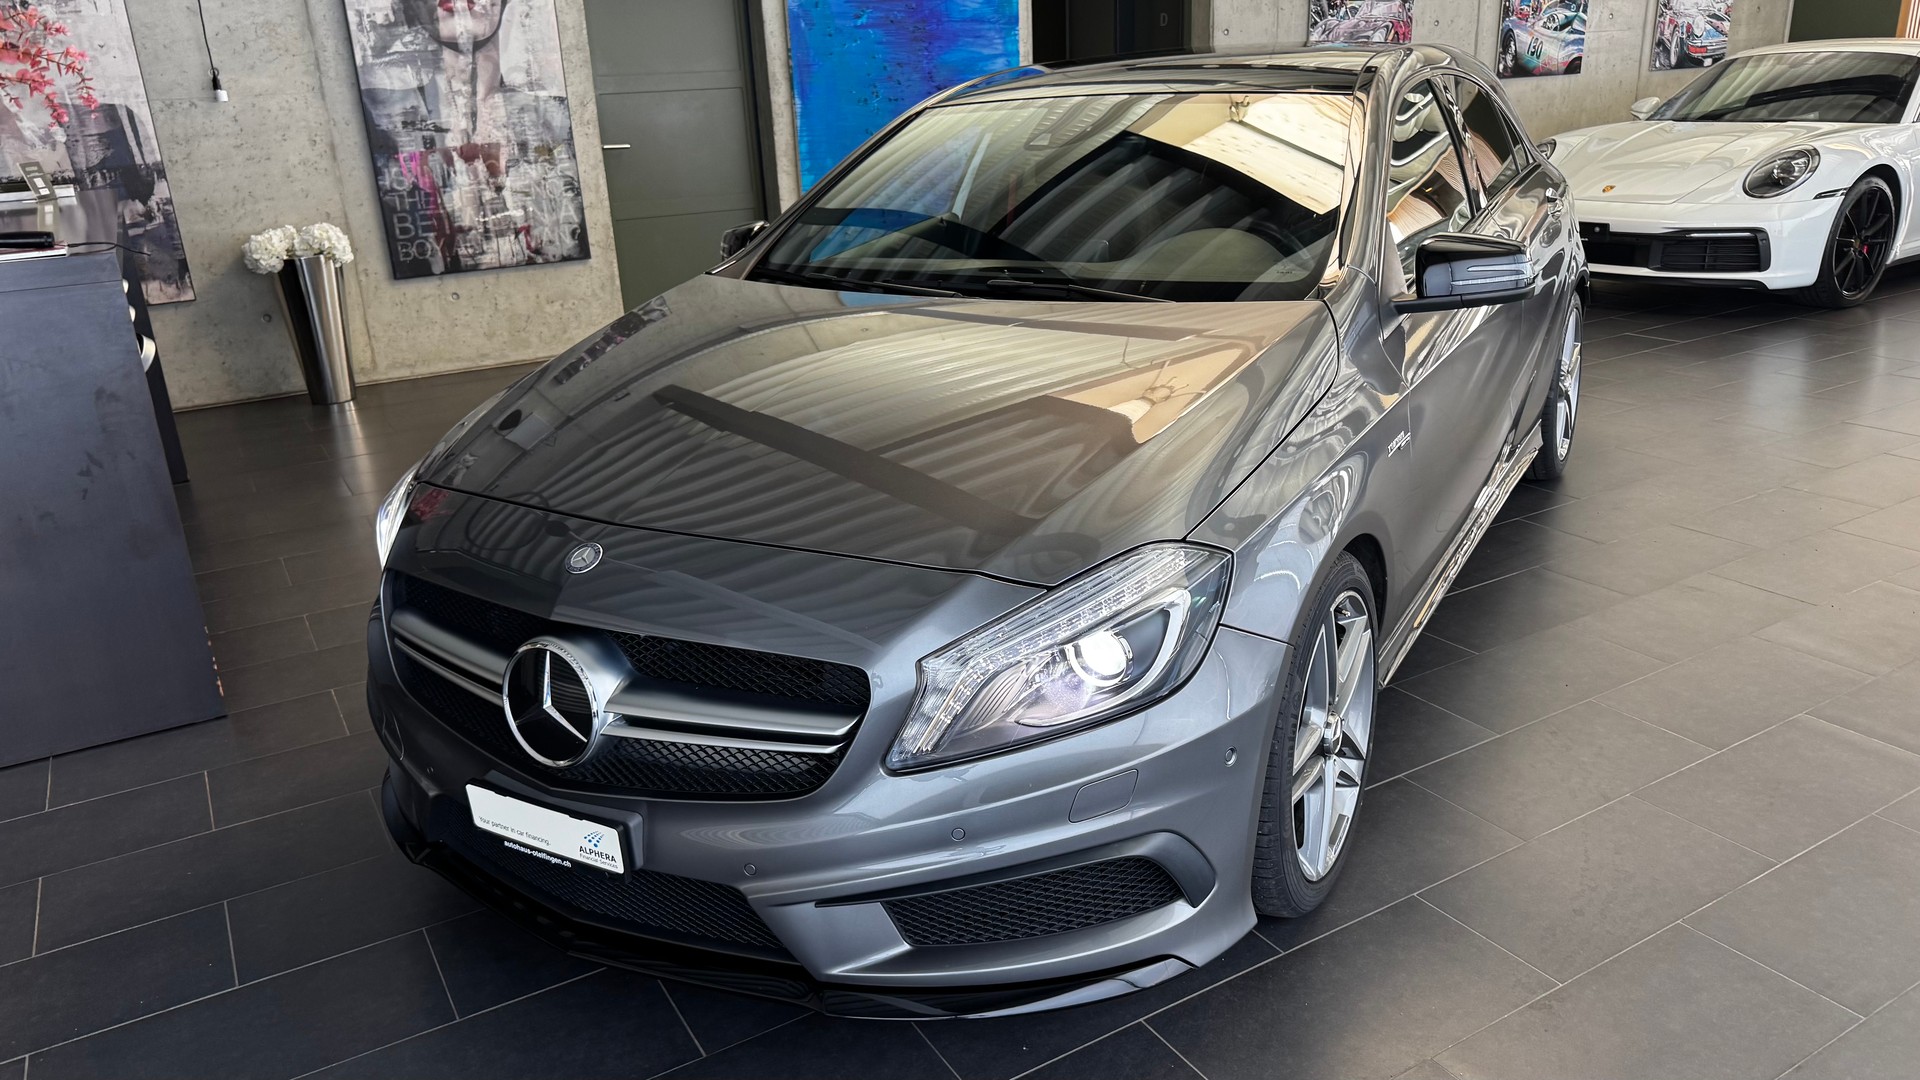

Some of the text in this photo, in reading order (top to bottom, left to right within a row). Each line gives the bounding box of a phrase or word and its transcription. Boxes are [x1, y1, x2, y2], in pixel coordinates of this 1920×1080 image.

[1526, 36, 1543, 60] 130
[491, 821, 509, 832] partner
[516, 829, 524, 837] car
[525, 831, 551, 847] financing.
[579, 845, 617, 863] ALPHERA
[579, 853, 618, 869] Financial Services
